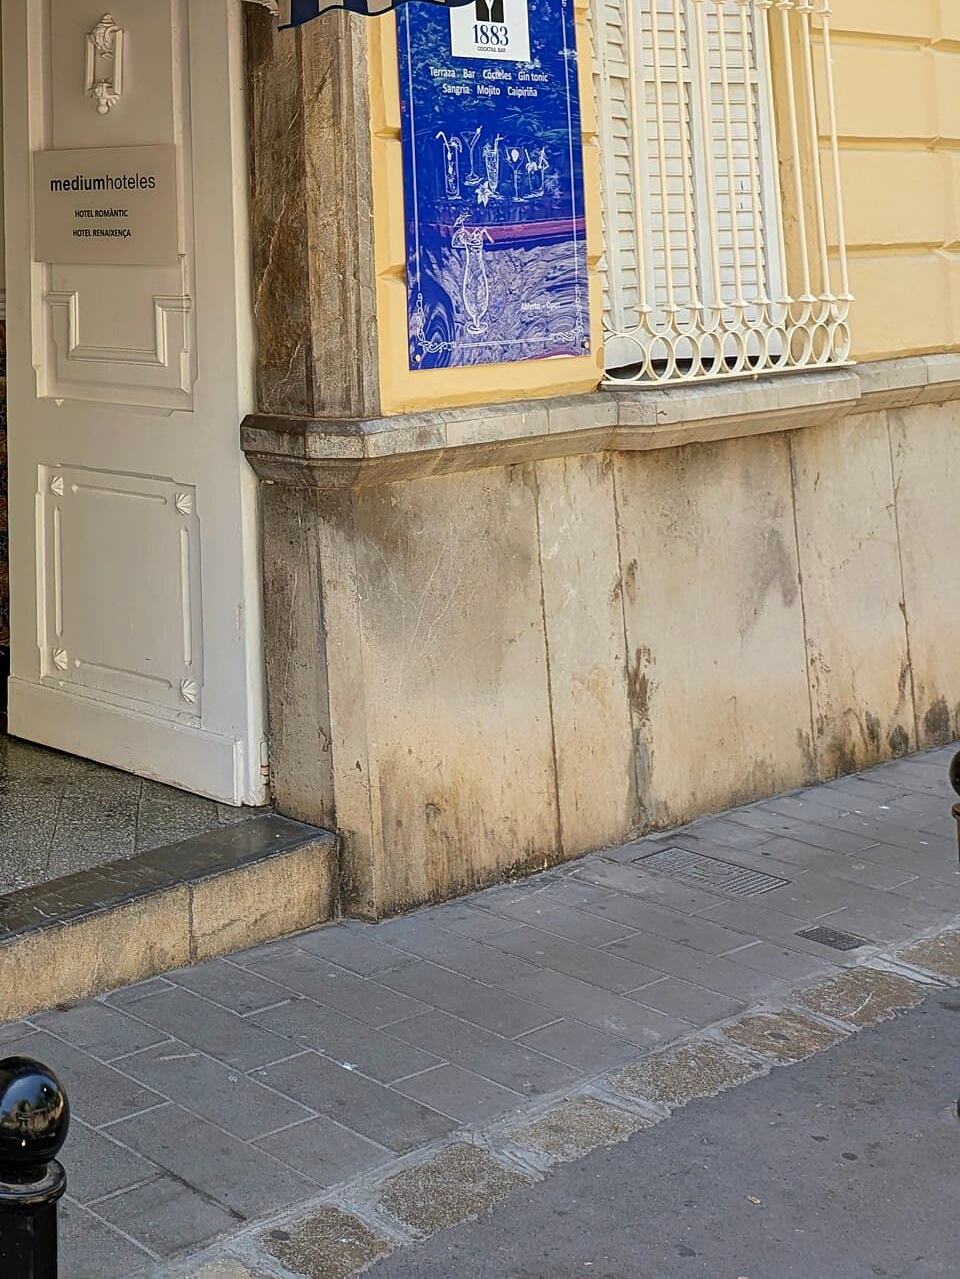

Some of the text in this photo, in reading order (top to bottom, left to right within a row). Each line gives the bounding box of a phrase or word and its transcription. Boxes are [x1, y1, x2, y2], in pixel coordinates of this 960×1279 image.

[472, 24, 509, 47] 1883
[428, 66, 456, 79] Terraza
[463, 68, 475, 79] Bar
[517, 71, 530, 82] Gin
[531, 72, 549, 83] tonic
[476, 85, 501, 97] Mojito
[50, 173, 156, 192] mediumhoteles
[74, 209, 94, 218] HOTEL
[72, 229, 132, 239] HOTEL RENAIXENÇA
